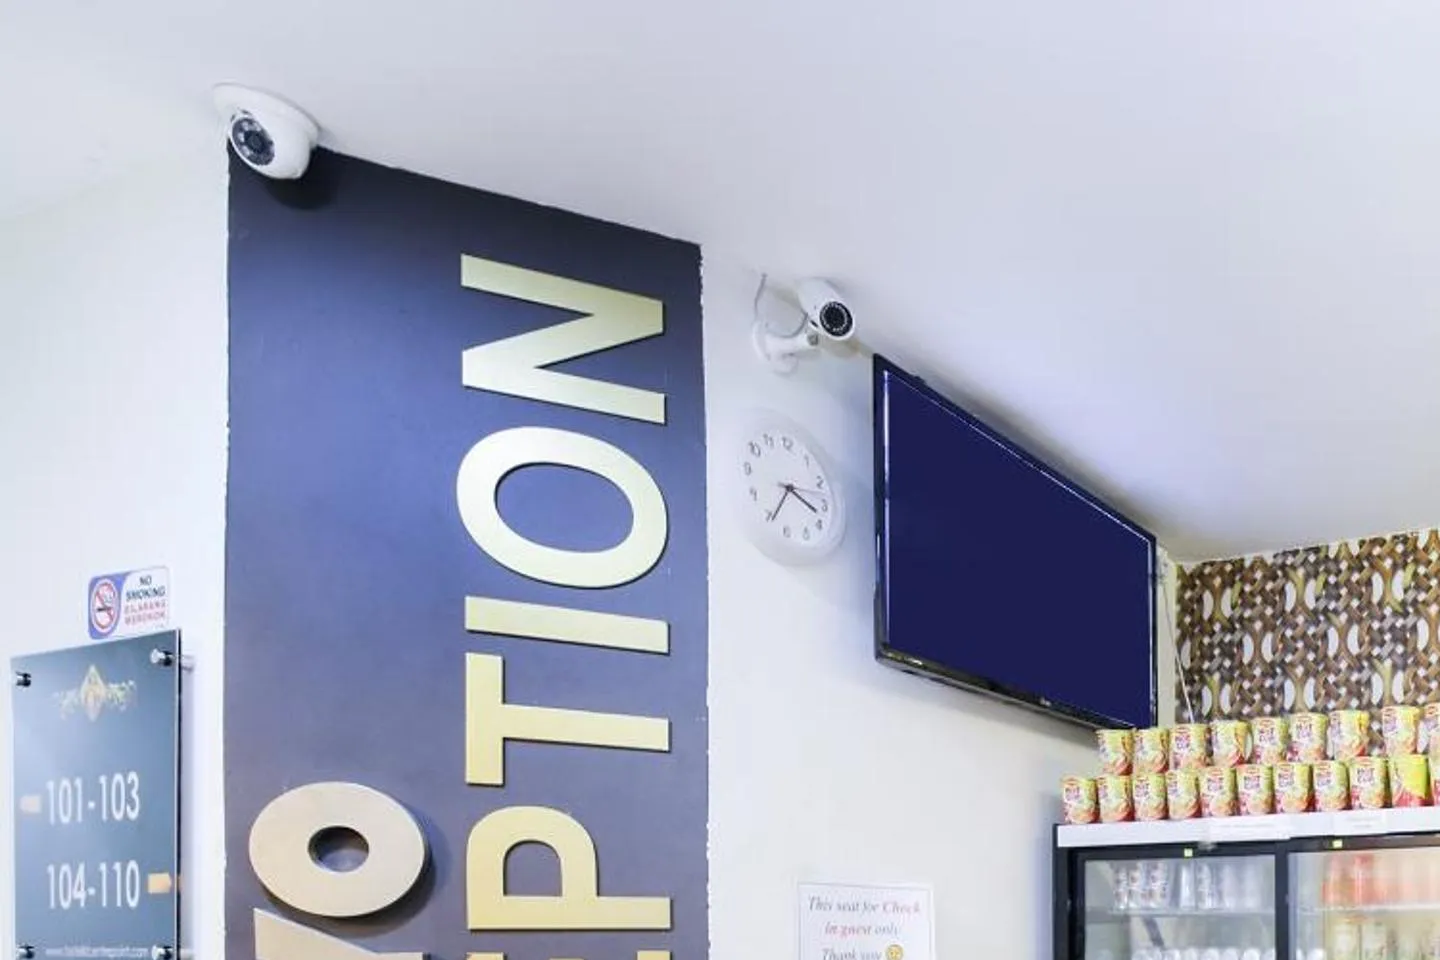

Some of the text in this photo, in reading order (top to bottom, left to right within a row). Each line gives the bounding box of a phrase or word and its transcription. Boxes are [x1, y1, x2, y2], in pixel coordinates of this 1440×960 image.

[139, 574, 152, 586] NO
[126, 585, 166, 602] SMOKING
[46, 770, 140, 825] 101-103
[47, 859, 140, 909] 104-110
[808, 895, 922, 917] This seat for Check
[840, 924, 872, 938] guest
